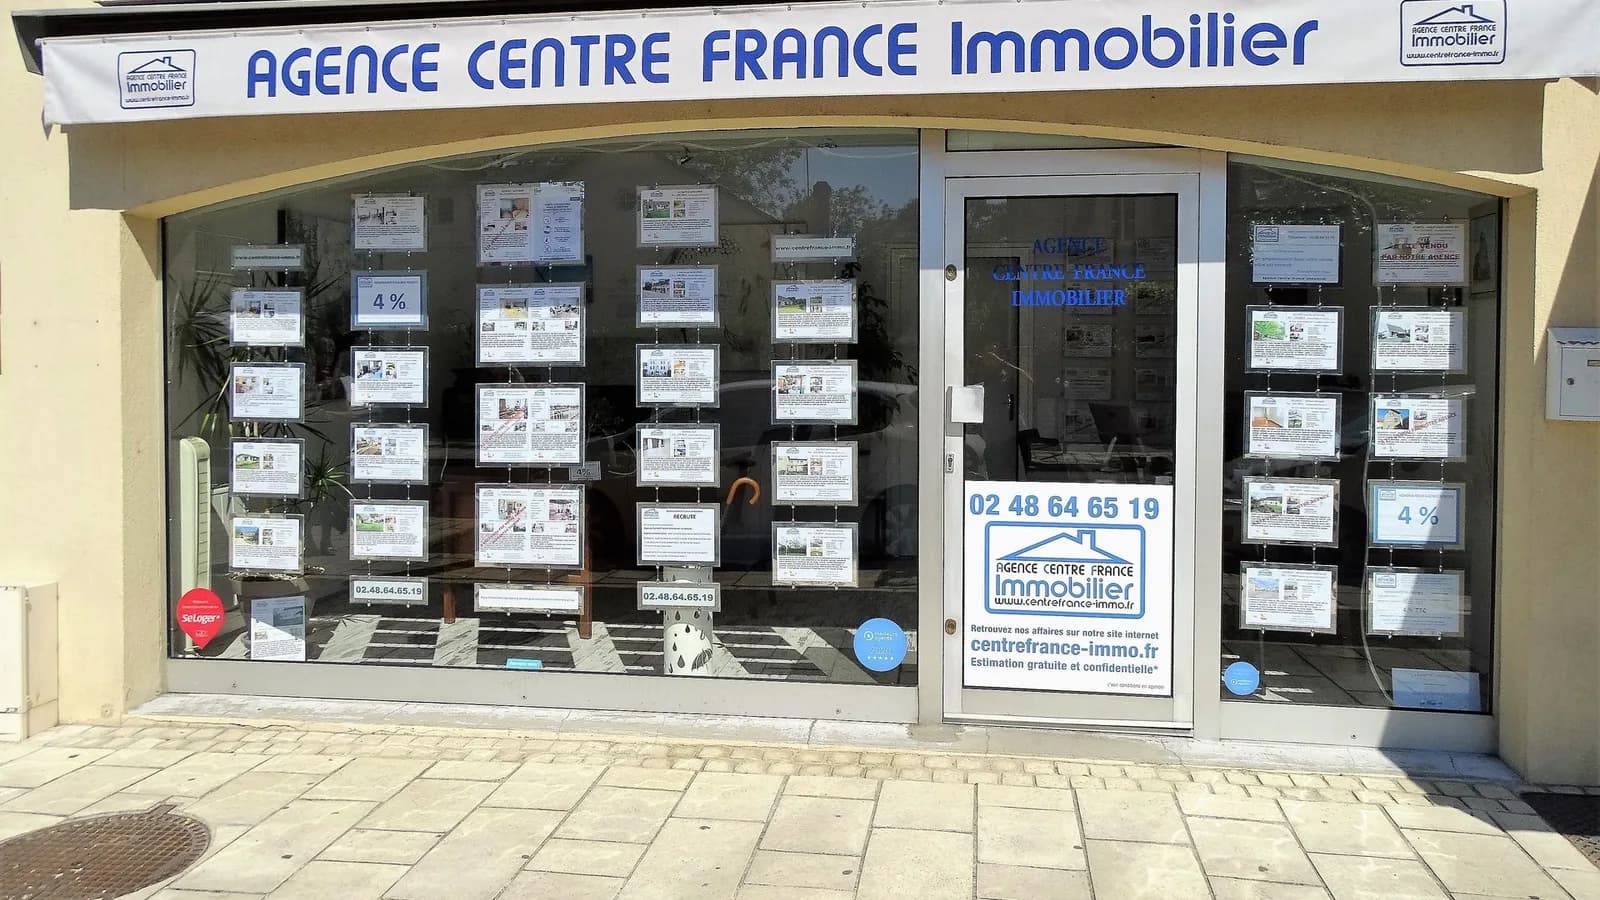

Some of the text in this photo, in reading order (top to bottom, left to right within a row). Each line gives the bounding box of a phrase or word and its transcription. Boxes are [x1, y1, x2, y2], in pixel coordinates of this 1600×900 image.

[1412, 33, 1496, 47] Immobilier
[248, 13, 1319, 98] AGENCE CENTRE FRANCE Immobilier
[127, 80, 187, 92] Immobilier
[992, 262, 1146, 281] CENTRE FRANCE
[373, 293, 406, 310] 4 %
[1011, 289, 1126, 307] IMMOBILIER
[969, 493, 1160, 520] 02 48 64 65 19
[1398, 506, 1439, 526] 4 %
[996, 562, 1134, 577] AGENCE CENTRE FRANCE
[355, 586, 422, 595] 02.48.64.65.19
[995, 574, 1134, 600] Immobilier
[643, 592, 714, 602] 02.48.64.65.19
[994, 597, 1135, 610] www.centrefrance-immo.fr
[970, 624, 1013, 634] Retrouvez
[1032, 626, 1064, 636] affaires
[1082, 629, 1105, 638] notre
[1107, 630, 1123, 638] site
[1125, 630, 1159, 640] internet
[970, 637, 1159, 659] centrefrance-immo.fr
[970, 657, 1024, 669] Estimation
[1027, 660, 1068, 671] gratuite
[1070, 662, 1080, 671] et
